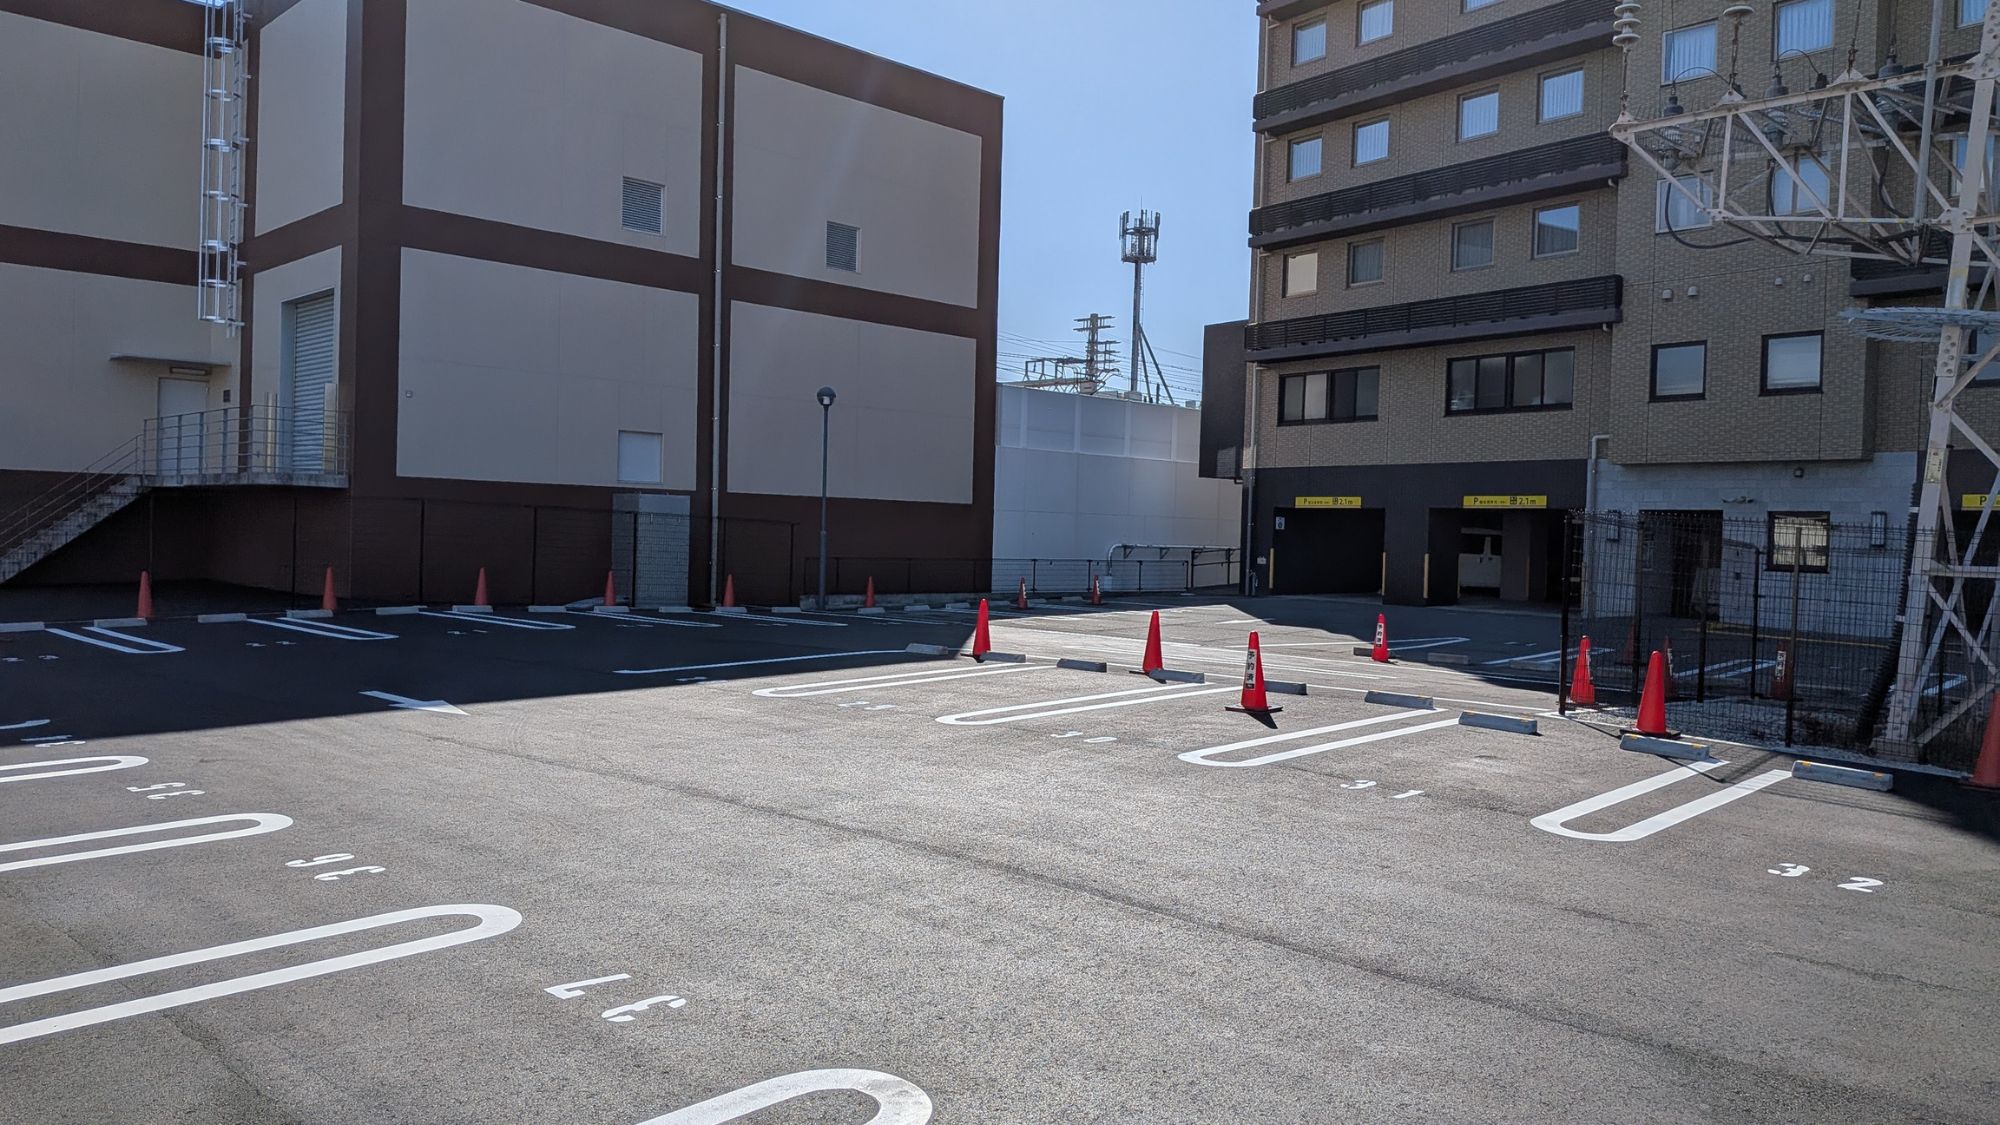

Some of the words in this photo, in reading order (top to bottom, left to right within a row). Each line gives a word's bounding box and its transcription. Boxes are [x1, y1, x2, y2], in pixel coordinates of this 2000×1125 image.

[1339, 779, 1425, 799] 31
[284, 853, 386, 881] 36
[1767, 863, 1884, 893] 32
[543, 973, 689, 1024] 37
